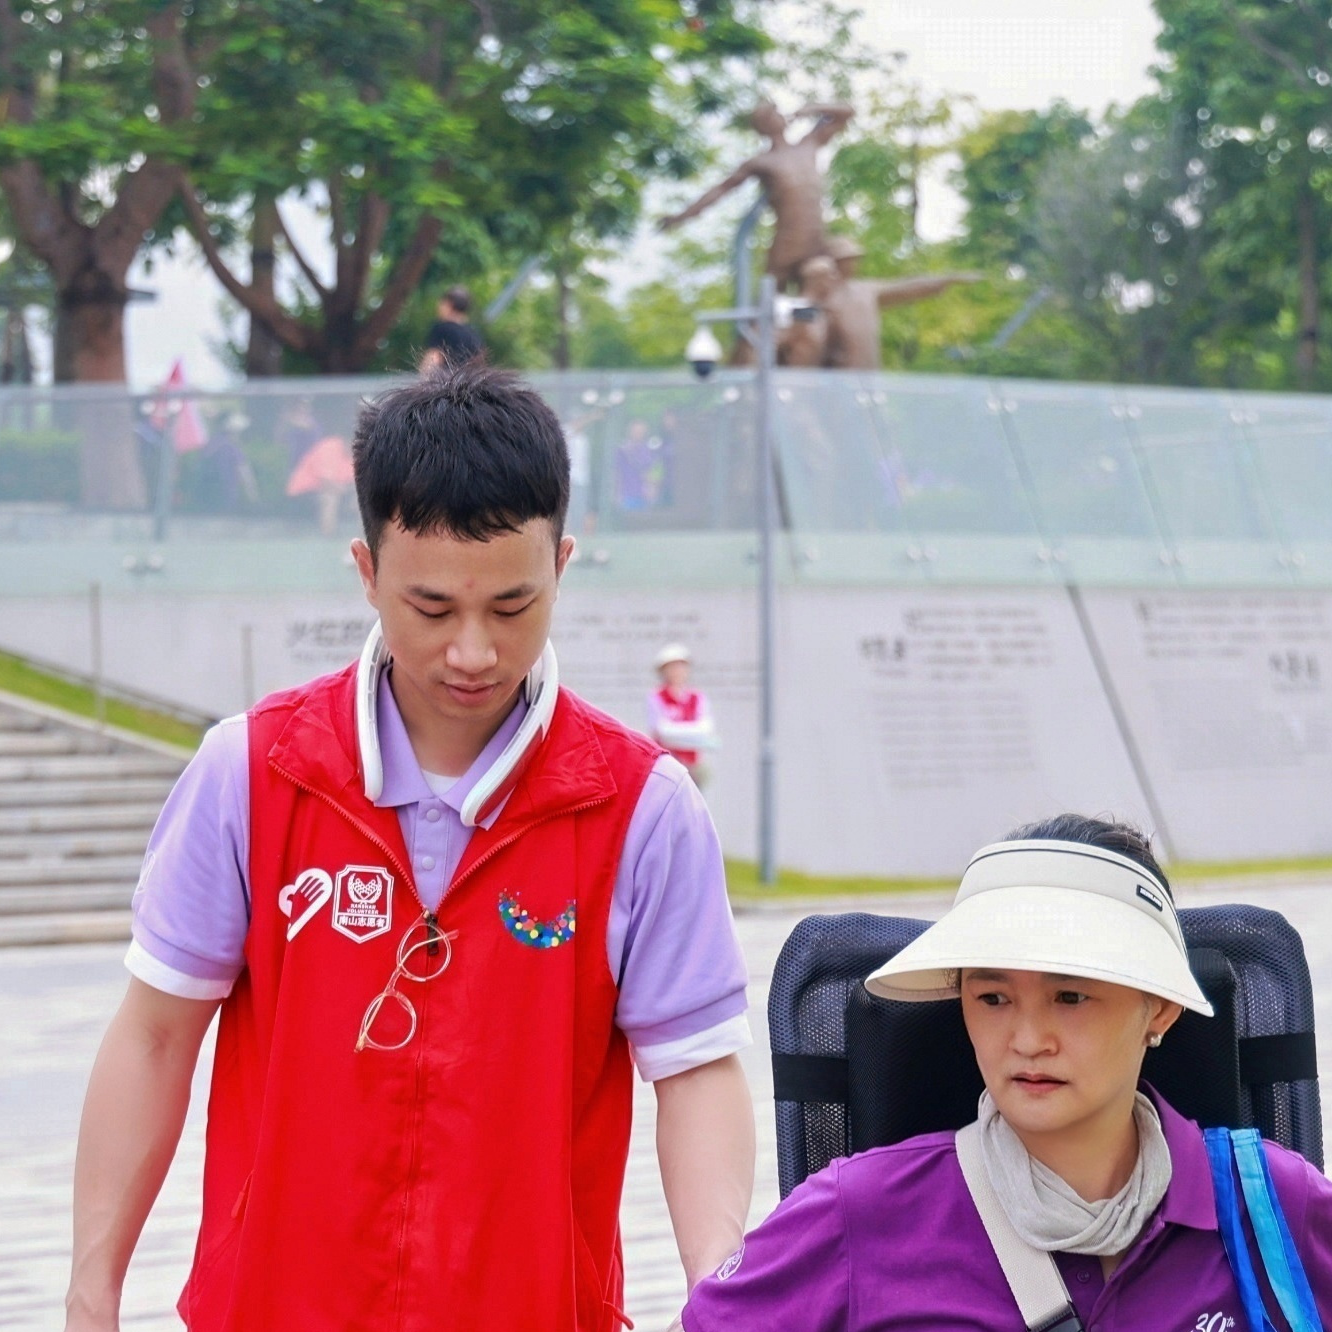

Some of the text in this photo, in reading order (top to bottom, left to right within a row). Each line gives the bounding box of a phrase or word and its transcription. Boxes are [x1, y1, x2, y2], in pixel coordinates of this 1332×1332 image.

[339, 916, 385, 927] 南山志愿者
